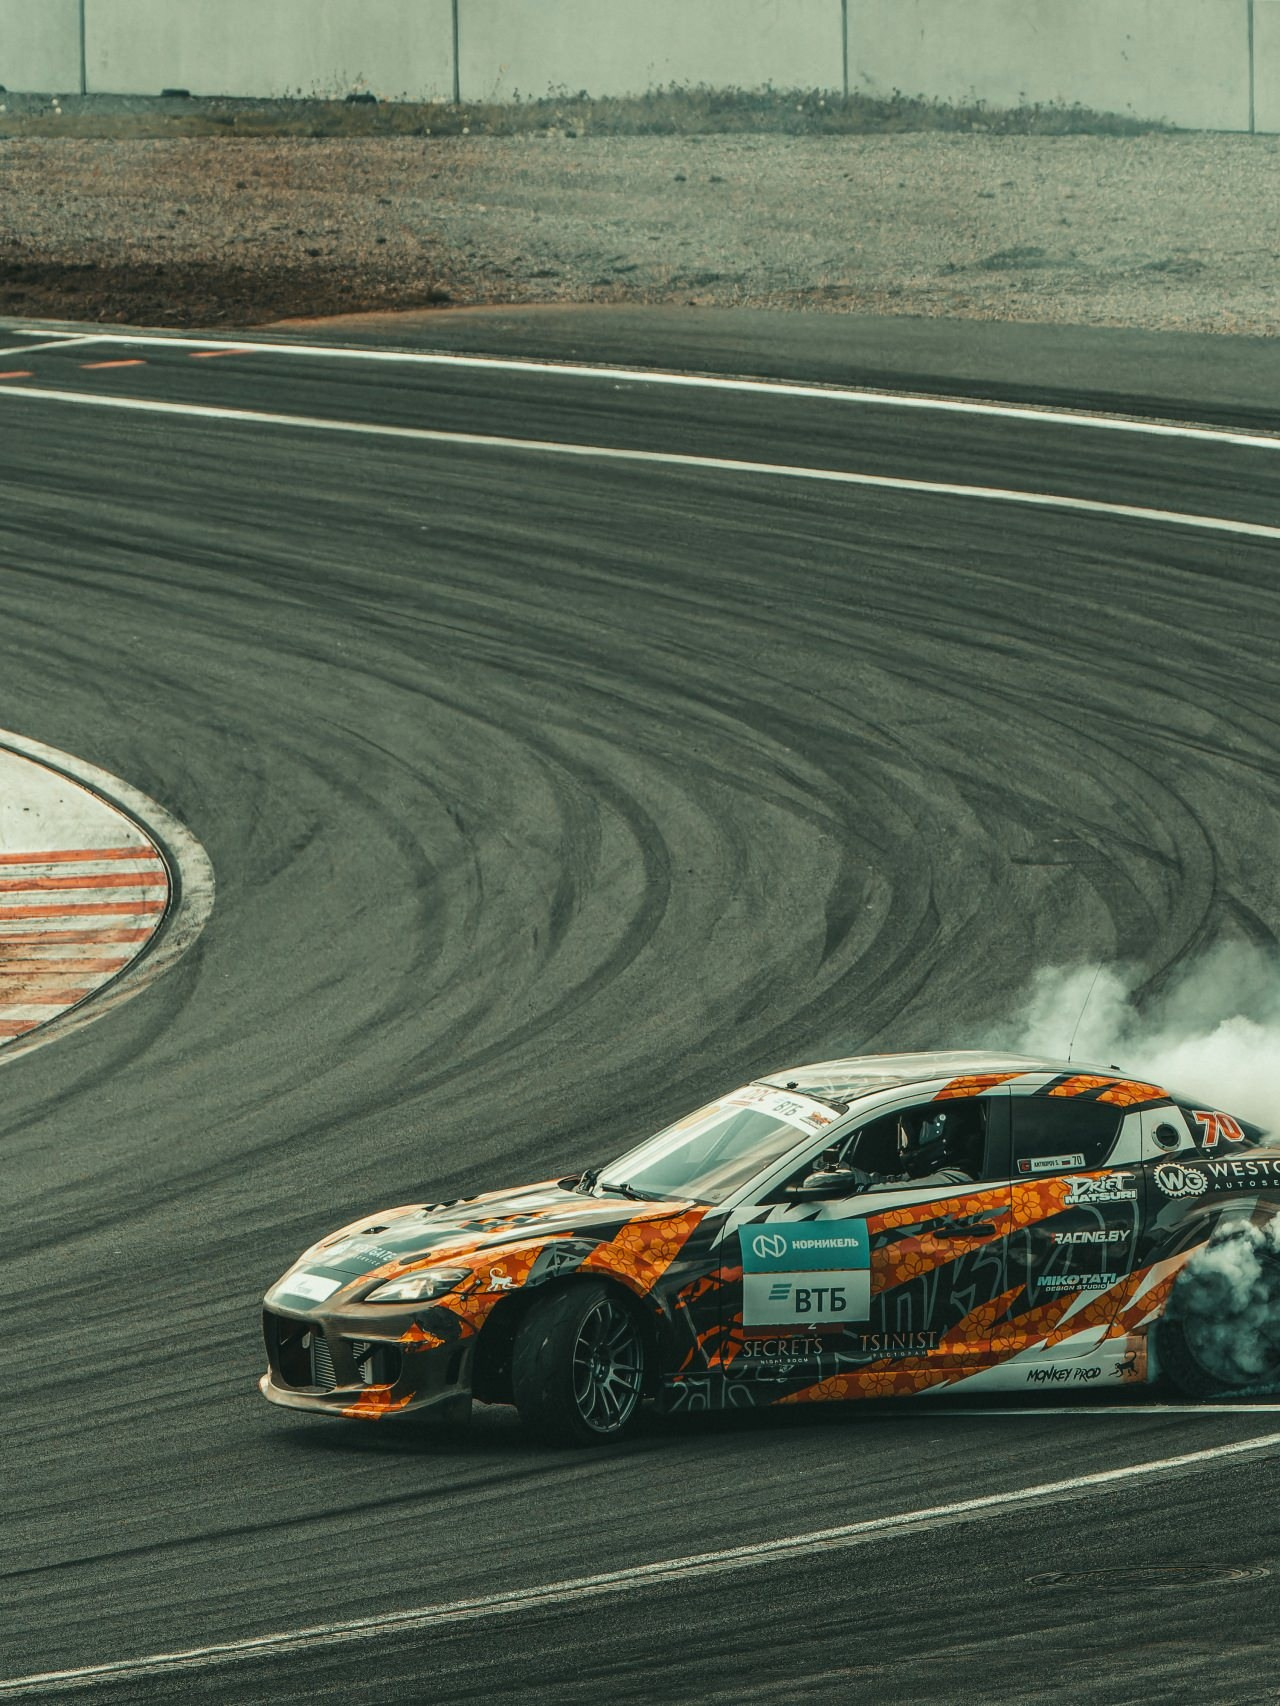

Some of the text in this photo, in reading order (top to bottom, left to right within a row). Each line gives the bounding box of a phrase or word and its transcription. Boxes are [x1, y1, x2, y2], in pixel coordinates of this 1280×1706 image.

[772, 1101, 804, 1116] ВТБ
[1192, 1111, 1245, 1148] 70
[1072, 1155, 1082, 1166] 70
[1064, 1190, 1136, 1205] MATSURI
[792, 1238, 859, 1249] НОРНИКЕЛЬ
[1054, 1230, 1131, 1244] RACING.BY
[1037, 1273, 1117, 1286] MIKOTATI
[795, 1287, 847, 1313] ВТБ
[743, 1338, 823, 1358] SECRETS
[859, 1331, 937, 1352] TSINIST
[1026, 1364, 1101, 1383] MONKEY PROD
